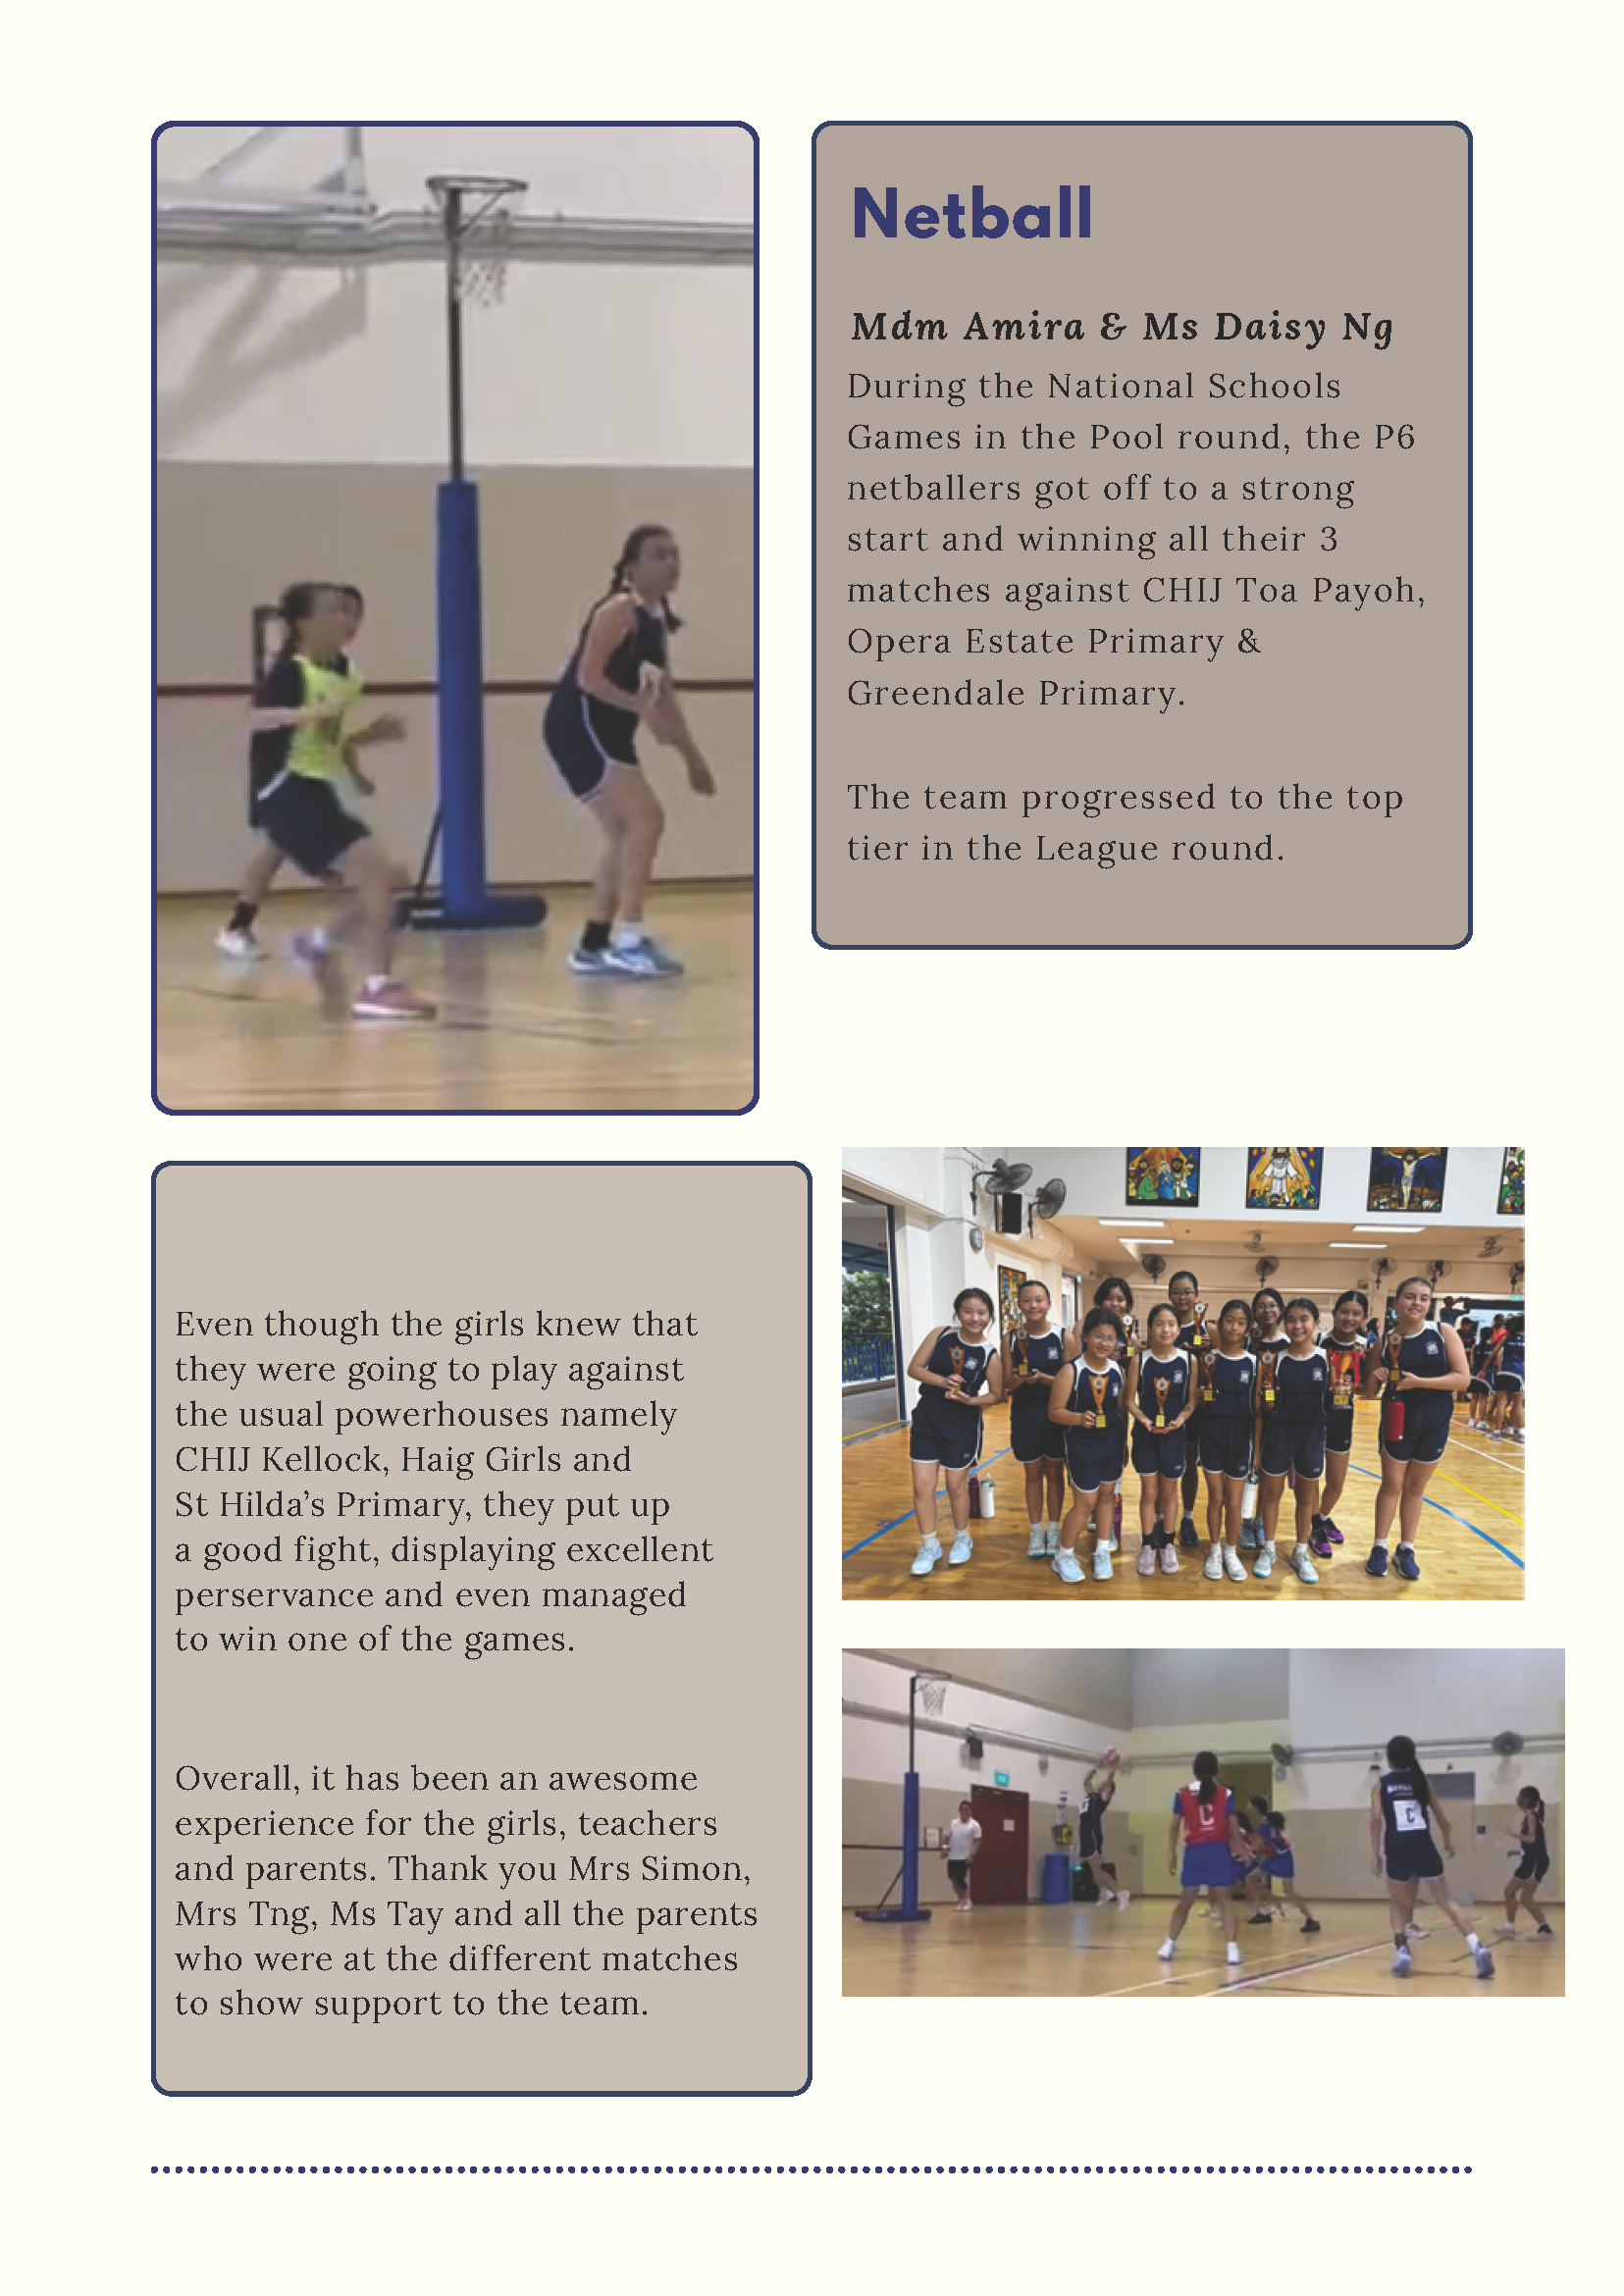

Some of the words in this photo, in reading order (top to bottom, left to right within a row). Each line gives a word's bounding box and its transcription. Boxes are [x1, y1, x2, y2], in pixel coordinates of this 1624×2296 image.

[855, 185, 1090, 238] Netball
[852, 310, 948, 339] Mdm
[964, 310, 1084, 339] Amira
[1101, 312, 1126, 340] &
[1143, 313, 1197, 339] Ms
[1215, 310, 1325, 350] Daisy
[1342, 313, 1391, 350] Ng
[849, 373, 966, 407] During
[979, 372, 1032, 398] the
[1049, 372, 1193, 398] National
[1210, 372, 1339, 398] Schools
[849, 424, 960, 449] Games
[975, 424, 1006, 448] in
[1022, 423, 1074, 449] the
[1091, 423, 1163, 449] Pool
[1179, 423, 1289, 454] round,
[1306, 423, 1359, 449] the
[1376, 424, 1414, 449] P6
[848, 474, 1020, 500] netballers
[1035, 477, 1089, 509] got
[1104, 474, 1151, 500] off
[1164, 477, 1196, 500] to
[1212, 482, 1228, 500] a
[1243, 477, 1354, 509] strong
[849, 528, 928, 551] start
[943, 525, 1003, 551] and
[1018, 526, 1156, 560] winning
[1170, 525, 1208, 551] all
[1223, 525, 1305, 551] their
[1321, 526, 1336, 551] 3
[848, 576, 989, 602] matches
[1006, 577, 1129, 611] against
[1144, 577, 1222, 602] CHIJ
[1236, 578, 1297, 602] Toa
[1314, 576, 1424, 611] Payoh,
[849, 628, 951, 661] Opera
[967, 629, 1073, 653] Estate
[1089, 628, 1224, 662] Primary
[1238, 628, 1261, 653] &
[849, 679, 1023, 705] Greendale
[1040, 680, 1183, 714] Primary.
[848, 783, 909, 809] The
[924, 786, 1007, 809] team
[1022, 783, 1215, 818] progressed
[1231, 786, 1262, 809] to
[1279, 783, 1332, 809] the
[1347, 786, 1402, 817] top
[848, 835, 908, 861] tier
[922, 835, 953, 860] in
[968, 834, 1021, 861] the
[1037, 836, 1157, 869] League
[1173, 834, 1283, 861] round.
[177, 1312, 253, 1336] Even
[265, 1310, 379, 1345] though
[392, 1310, 442, 1336] the
[455, 1310, 523, 1345] girls
[537, 1310, 621, 1336] knew
[633, 1310, 698, 1336] that
[176, 1355, 246, 1390] they
[257, 1363, 335, 1382] were
[348, 1356, 437, 1390] going
[448, 1358, 479, 1382] to
[492, 1355, 557, 1390] play
[569, 1356, 684, 1390] against
[176, 1400, 227, 1427] the
[239, 1400, 323, 1427] usual
[336, 1400, 548, 1435] powerhouses
[561, 1400, 677, 1435] namely
[177, 1446, 250, 1472] CHIJ
[263, 1445, 389, 1477] Kellock,
[402, 1446, 474, 1481] Haig
[487, 1445, 560, 1472] Girls
[574, 1445, 631, 1472] and
[177, 1491, 208, 1517] St
[221, 1490, 324, 1517] Hilda’s
[338, 1491, 471, 1526] Primary,
[484, 1490, 554, 1526] they
[566, 1493, 619, 1525] put
[631, 1498, 669, 1525] up
[176, 1543, 191, 1562] a
[204, 1536, 282, 1571] good
[294, 1536, 379, 1571] fight,
[392, 1536, 555, 1571] displaying
[567, 1536, 713, 1562] excellent
[176, 1589, 373, 1615] perservance
[386, 1581, 443, 1607] and
[456, 1589, 530, 1607] even
[543, 1581, 686, 1616] managed
[176, 1628, 207, 1651] to
[219, 1626, 277, 1650] win
[288, 1633, 346, 1651] one
[359, 1625, 392, 1651] of
[401, 1625, 451, 1651] the
[465, 1632, 573, 1660] games.
[177, 1764, 299, 1796] Overall,
[312, 1765, 335, 1791] it
[346, 1764, 398, 1791] has
[411, 1764, 489, 1791] been
[500, 1772, 538, 1791] an
[550, 1772, 697, 1791] awesome
[176, 1810, 353, 1844] experience
[366, 1809, 411, 1836] for
[424, 1809, 474, 1836] the
[488, 1809, 565, 1845] girls,
[579, 1809, 716, 1836] teachers
[1199, 1803, 1214, 1826] C
[1405, 1806, 1416, 1823] C
[176, 1854, 234, 1881] and
[246, 1857, 375, 1889] parents.
[389, 1854, 488, 1881] Thank
[498, 1862, 556, 1890] you
[569, 1856, 629, 1881] Mrs
[643, 1855, 750, 1886] Simon,
[176, 1902, 236, 1926] Mrs
[249, 1902, 317, 1935] Tng,
[331, 1902, 375, 1926] Ms
[388, 1902, 444, 1935] Tay
[455, 1900, 512, 1926] and
[525, 1900, 560, 1926] all
[573, 1900, 623, 1926] the
[637, 1903, 757, 1934] parents
[175, 1945, 241, 1971] who
[254, 1953, 332, 1971] were
[344, 1948, 375, 1971] at
[387, 1945, 437, 1971] the
[449, 1945, 591, 1971] different
[602, 1945, 737, 1971] matches
[176, 1992, 207, 2015] to
[221, 1989, 303, 2015] show
[316, 1992, 442, 2023] support
[453, 1992, 484, 2015] to
[498, 1989, 548, 2015] the
[560, 1992, 647, 2015] team.
